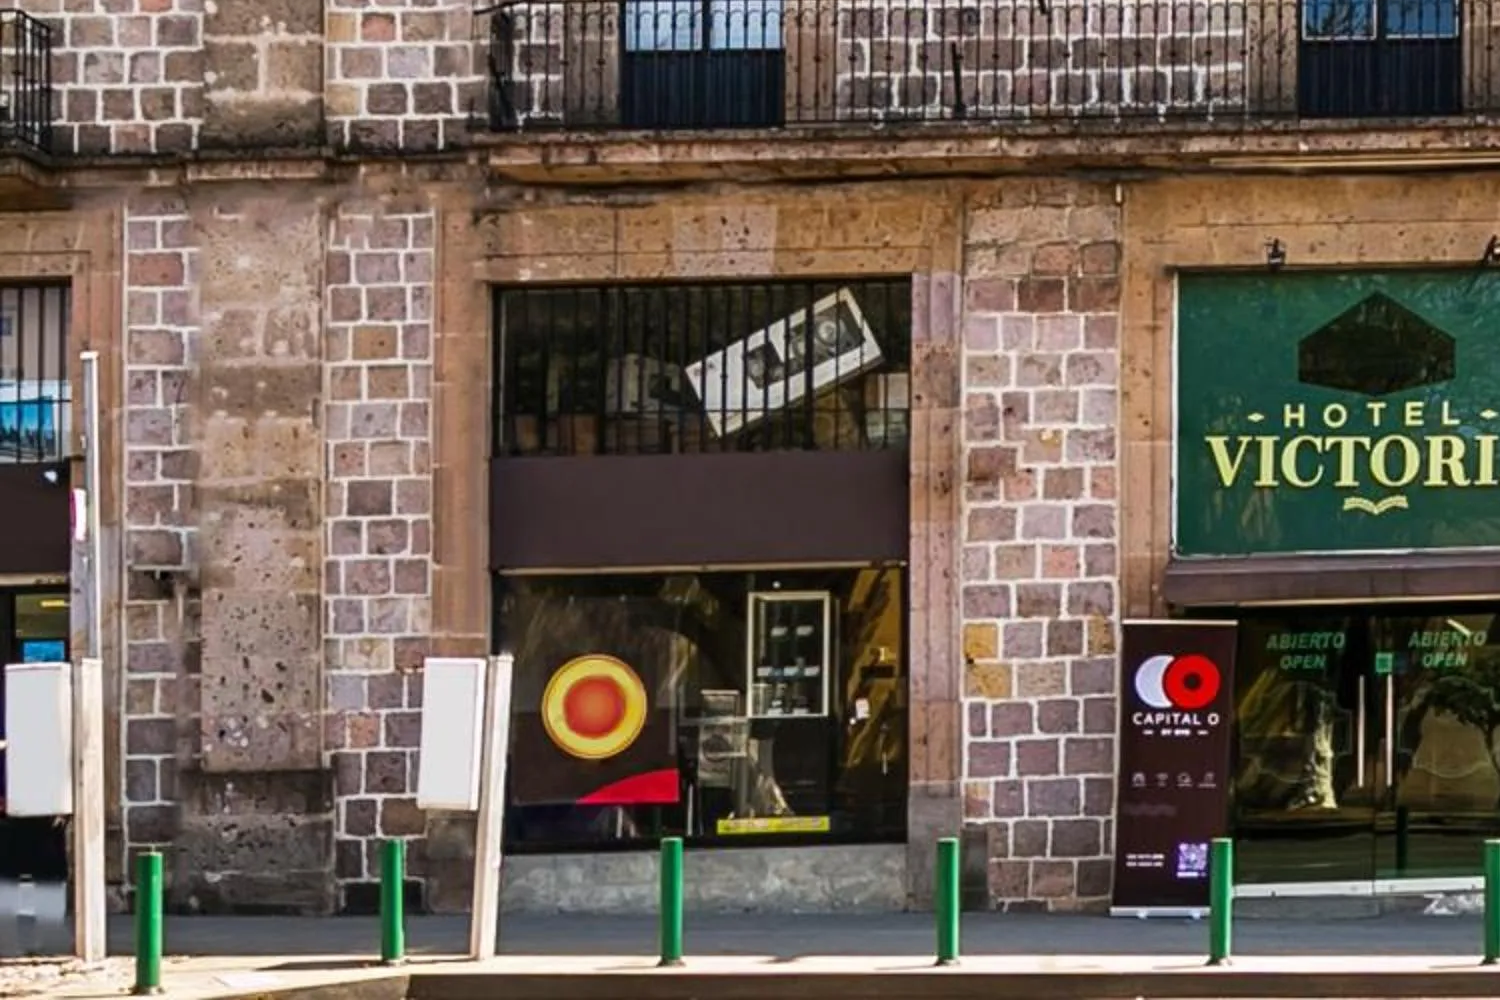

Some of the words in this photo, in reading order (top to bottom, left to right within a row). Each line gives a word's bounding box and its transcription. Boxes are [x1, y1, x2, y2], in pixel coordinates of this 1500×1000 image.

[1283, 400, 1461, 428] HOTEL
[1266, 631, 1346, 650] ABIERTO
[1407, 630, 1488, 648] ABIERTO
[1279, 653, 1327, 670] OPEN
[1421, 651, 1468, 669] OPEN
[1132, 711, 1202, 725] CAPITAL
[1207, 712, 1220, 726] O
